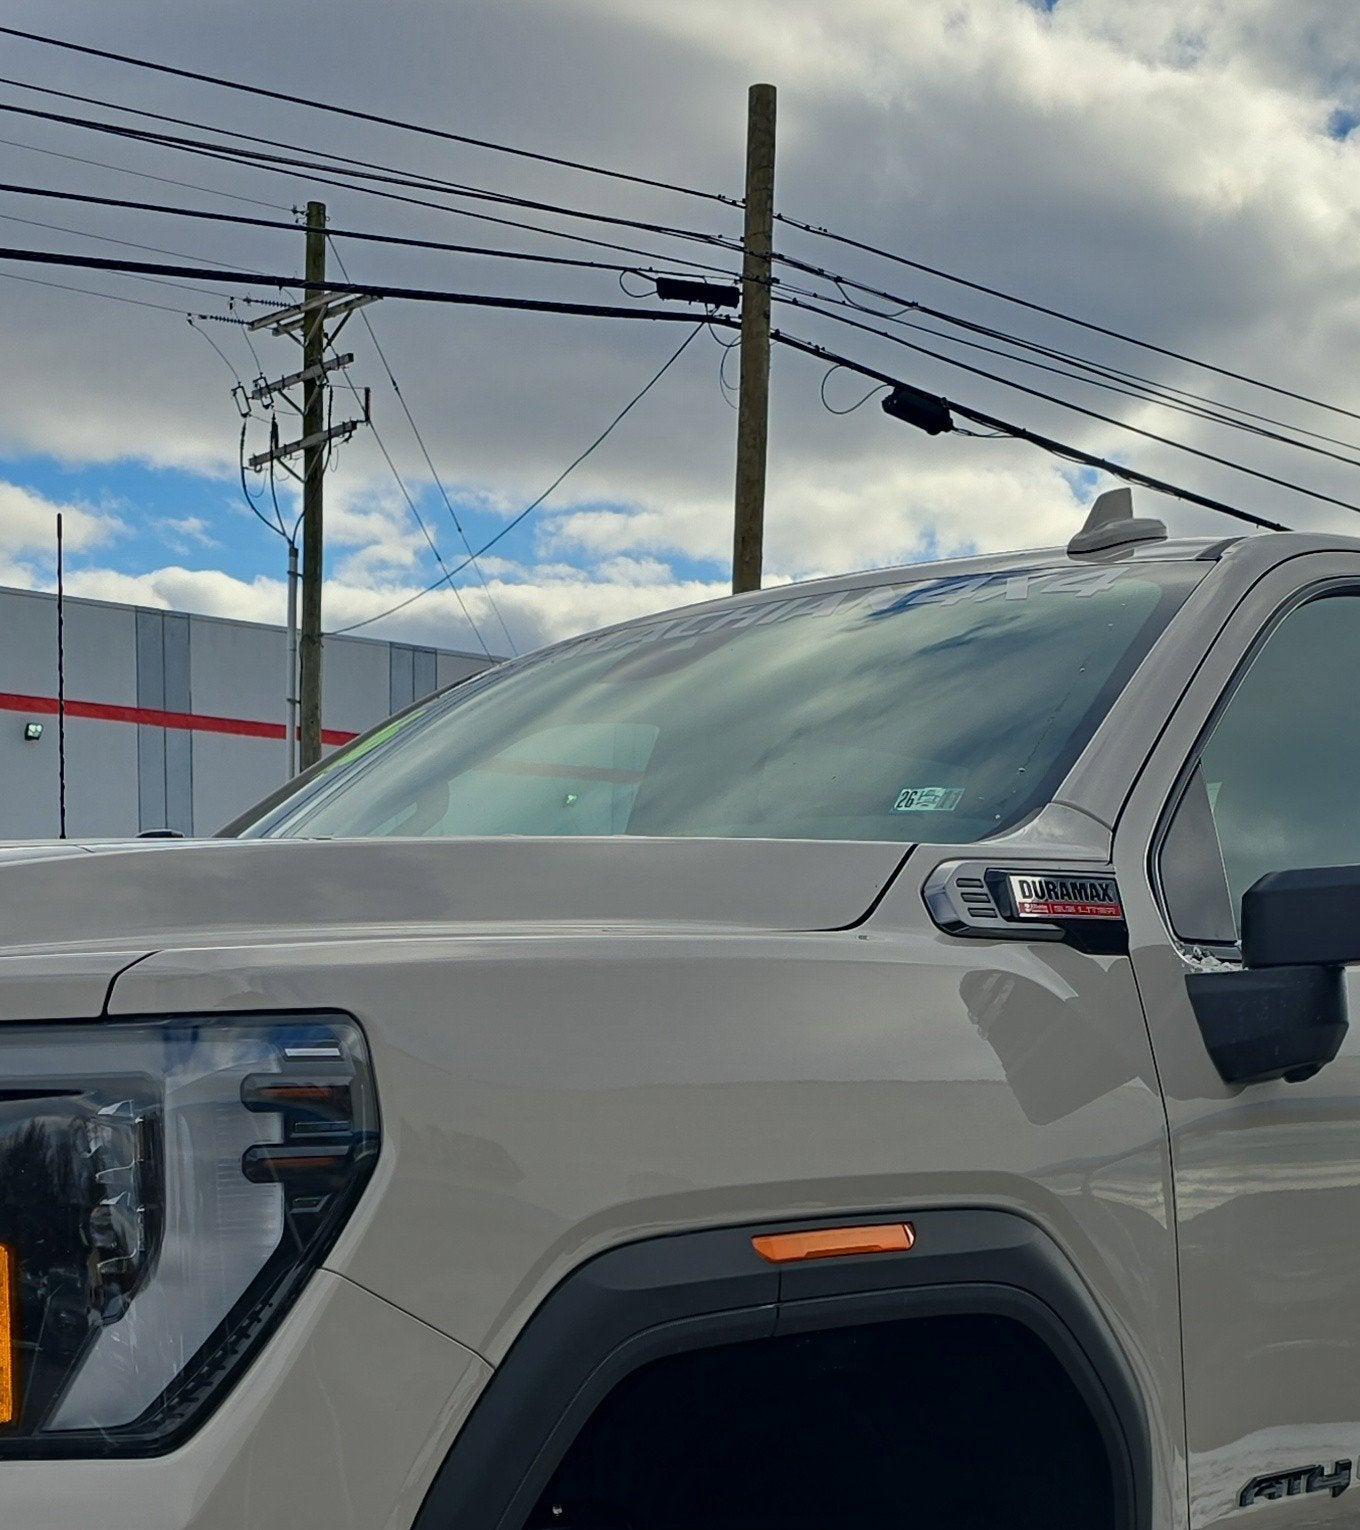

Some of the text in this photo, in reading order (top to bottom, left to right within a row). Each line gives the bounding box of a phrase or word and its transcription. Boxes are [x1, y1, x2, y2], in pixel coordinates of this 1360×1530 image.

[896, 790, 918, 808] 26
[1018, 879, 1114, 903] DURAMAX
[1237, 1458, 1352, 1508] AT4
